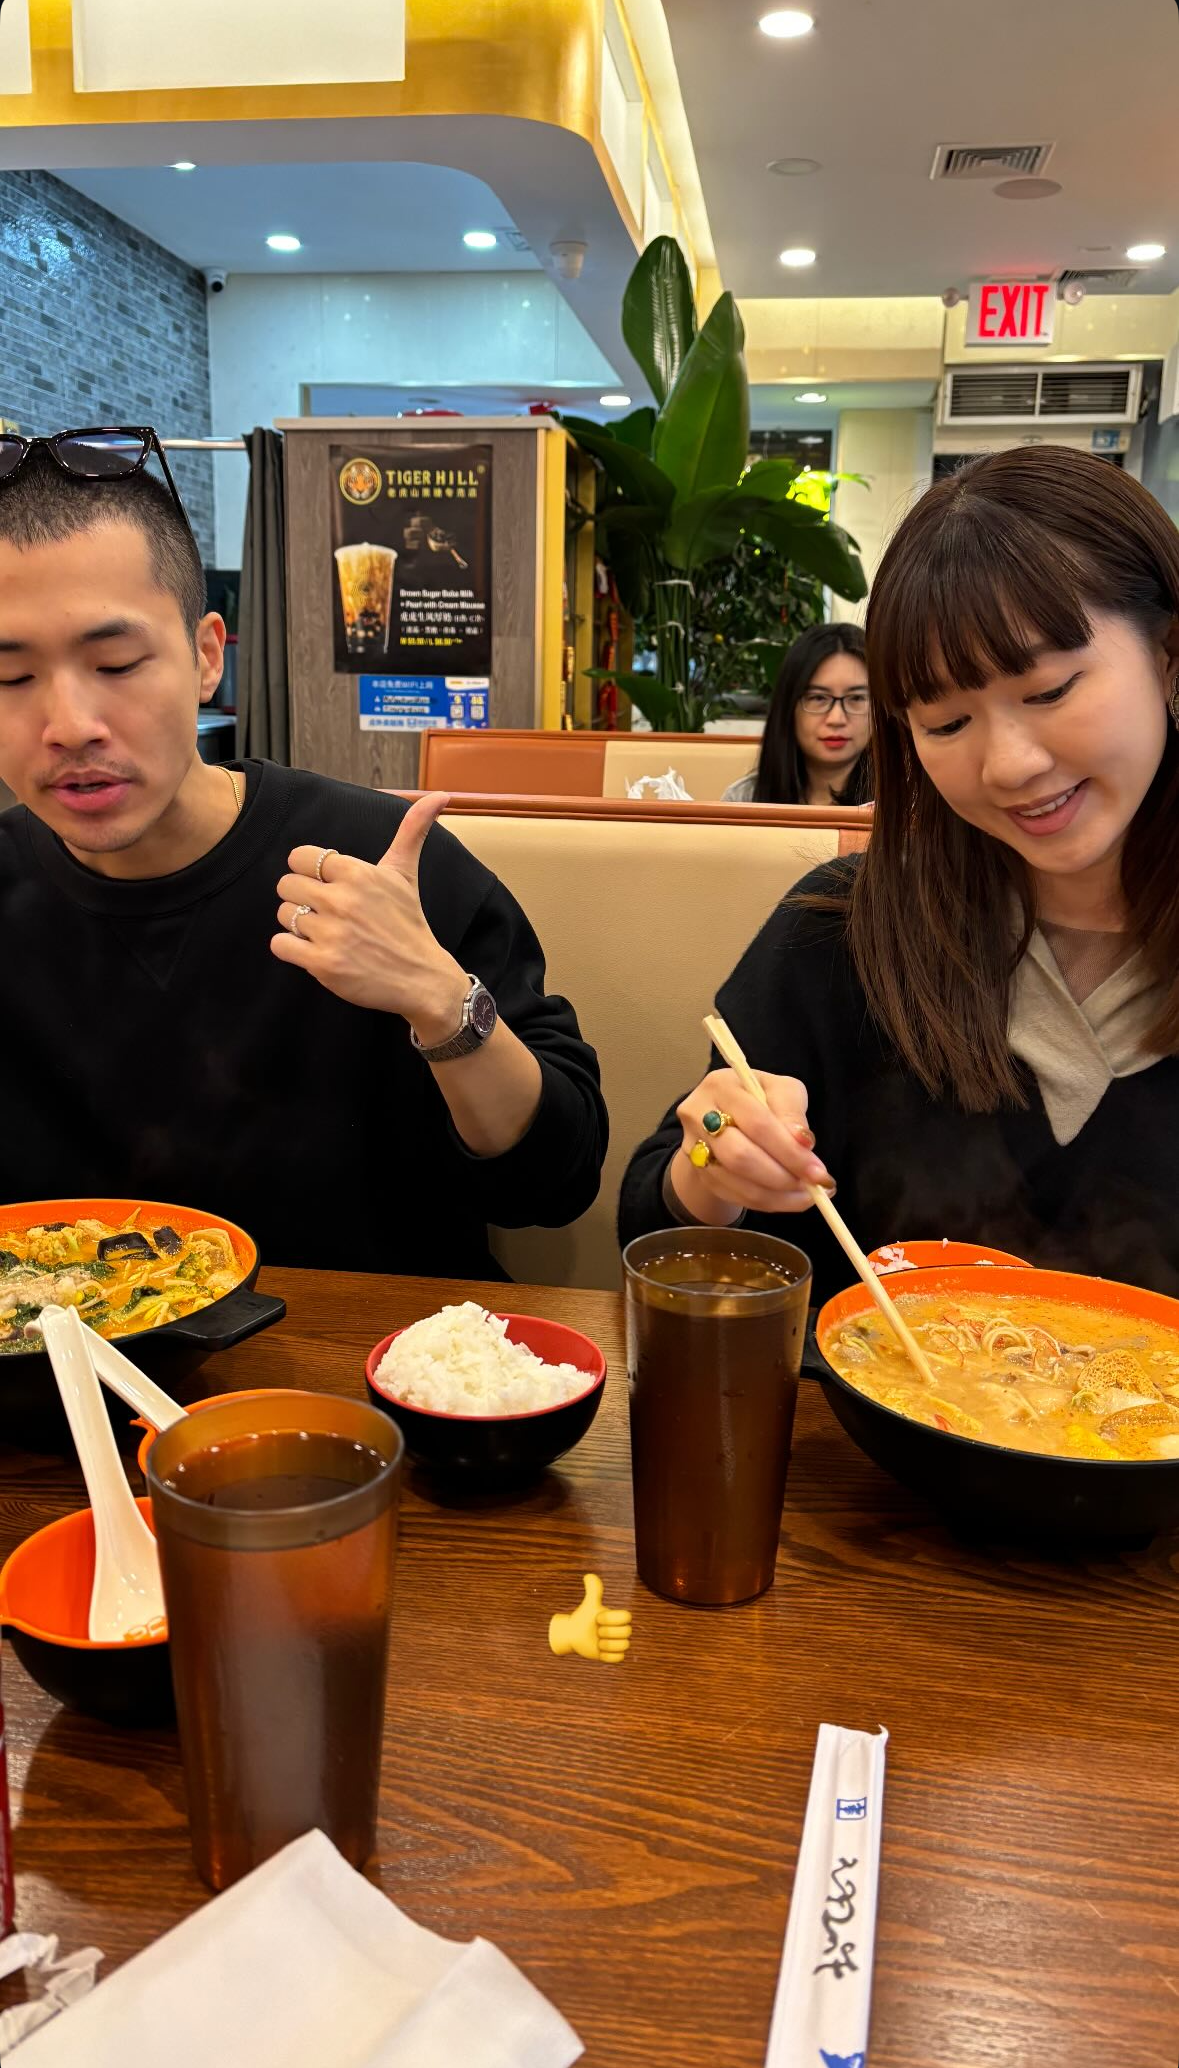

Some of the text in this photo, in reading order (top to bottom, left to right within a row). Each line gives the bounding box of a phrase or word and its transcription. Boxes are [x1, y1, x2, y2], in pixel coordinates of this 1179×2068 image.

[978, 285, 1050, 337] EXIT
[385, 470, 479, 486] TIGER HILL
[399, 588, 474, 600] Brown Sugar Boba Milk
[423, 601, 437, 610] with
[437, 600, 460, 610] Cream
[459, 600, 486, 610] Mousse
